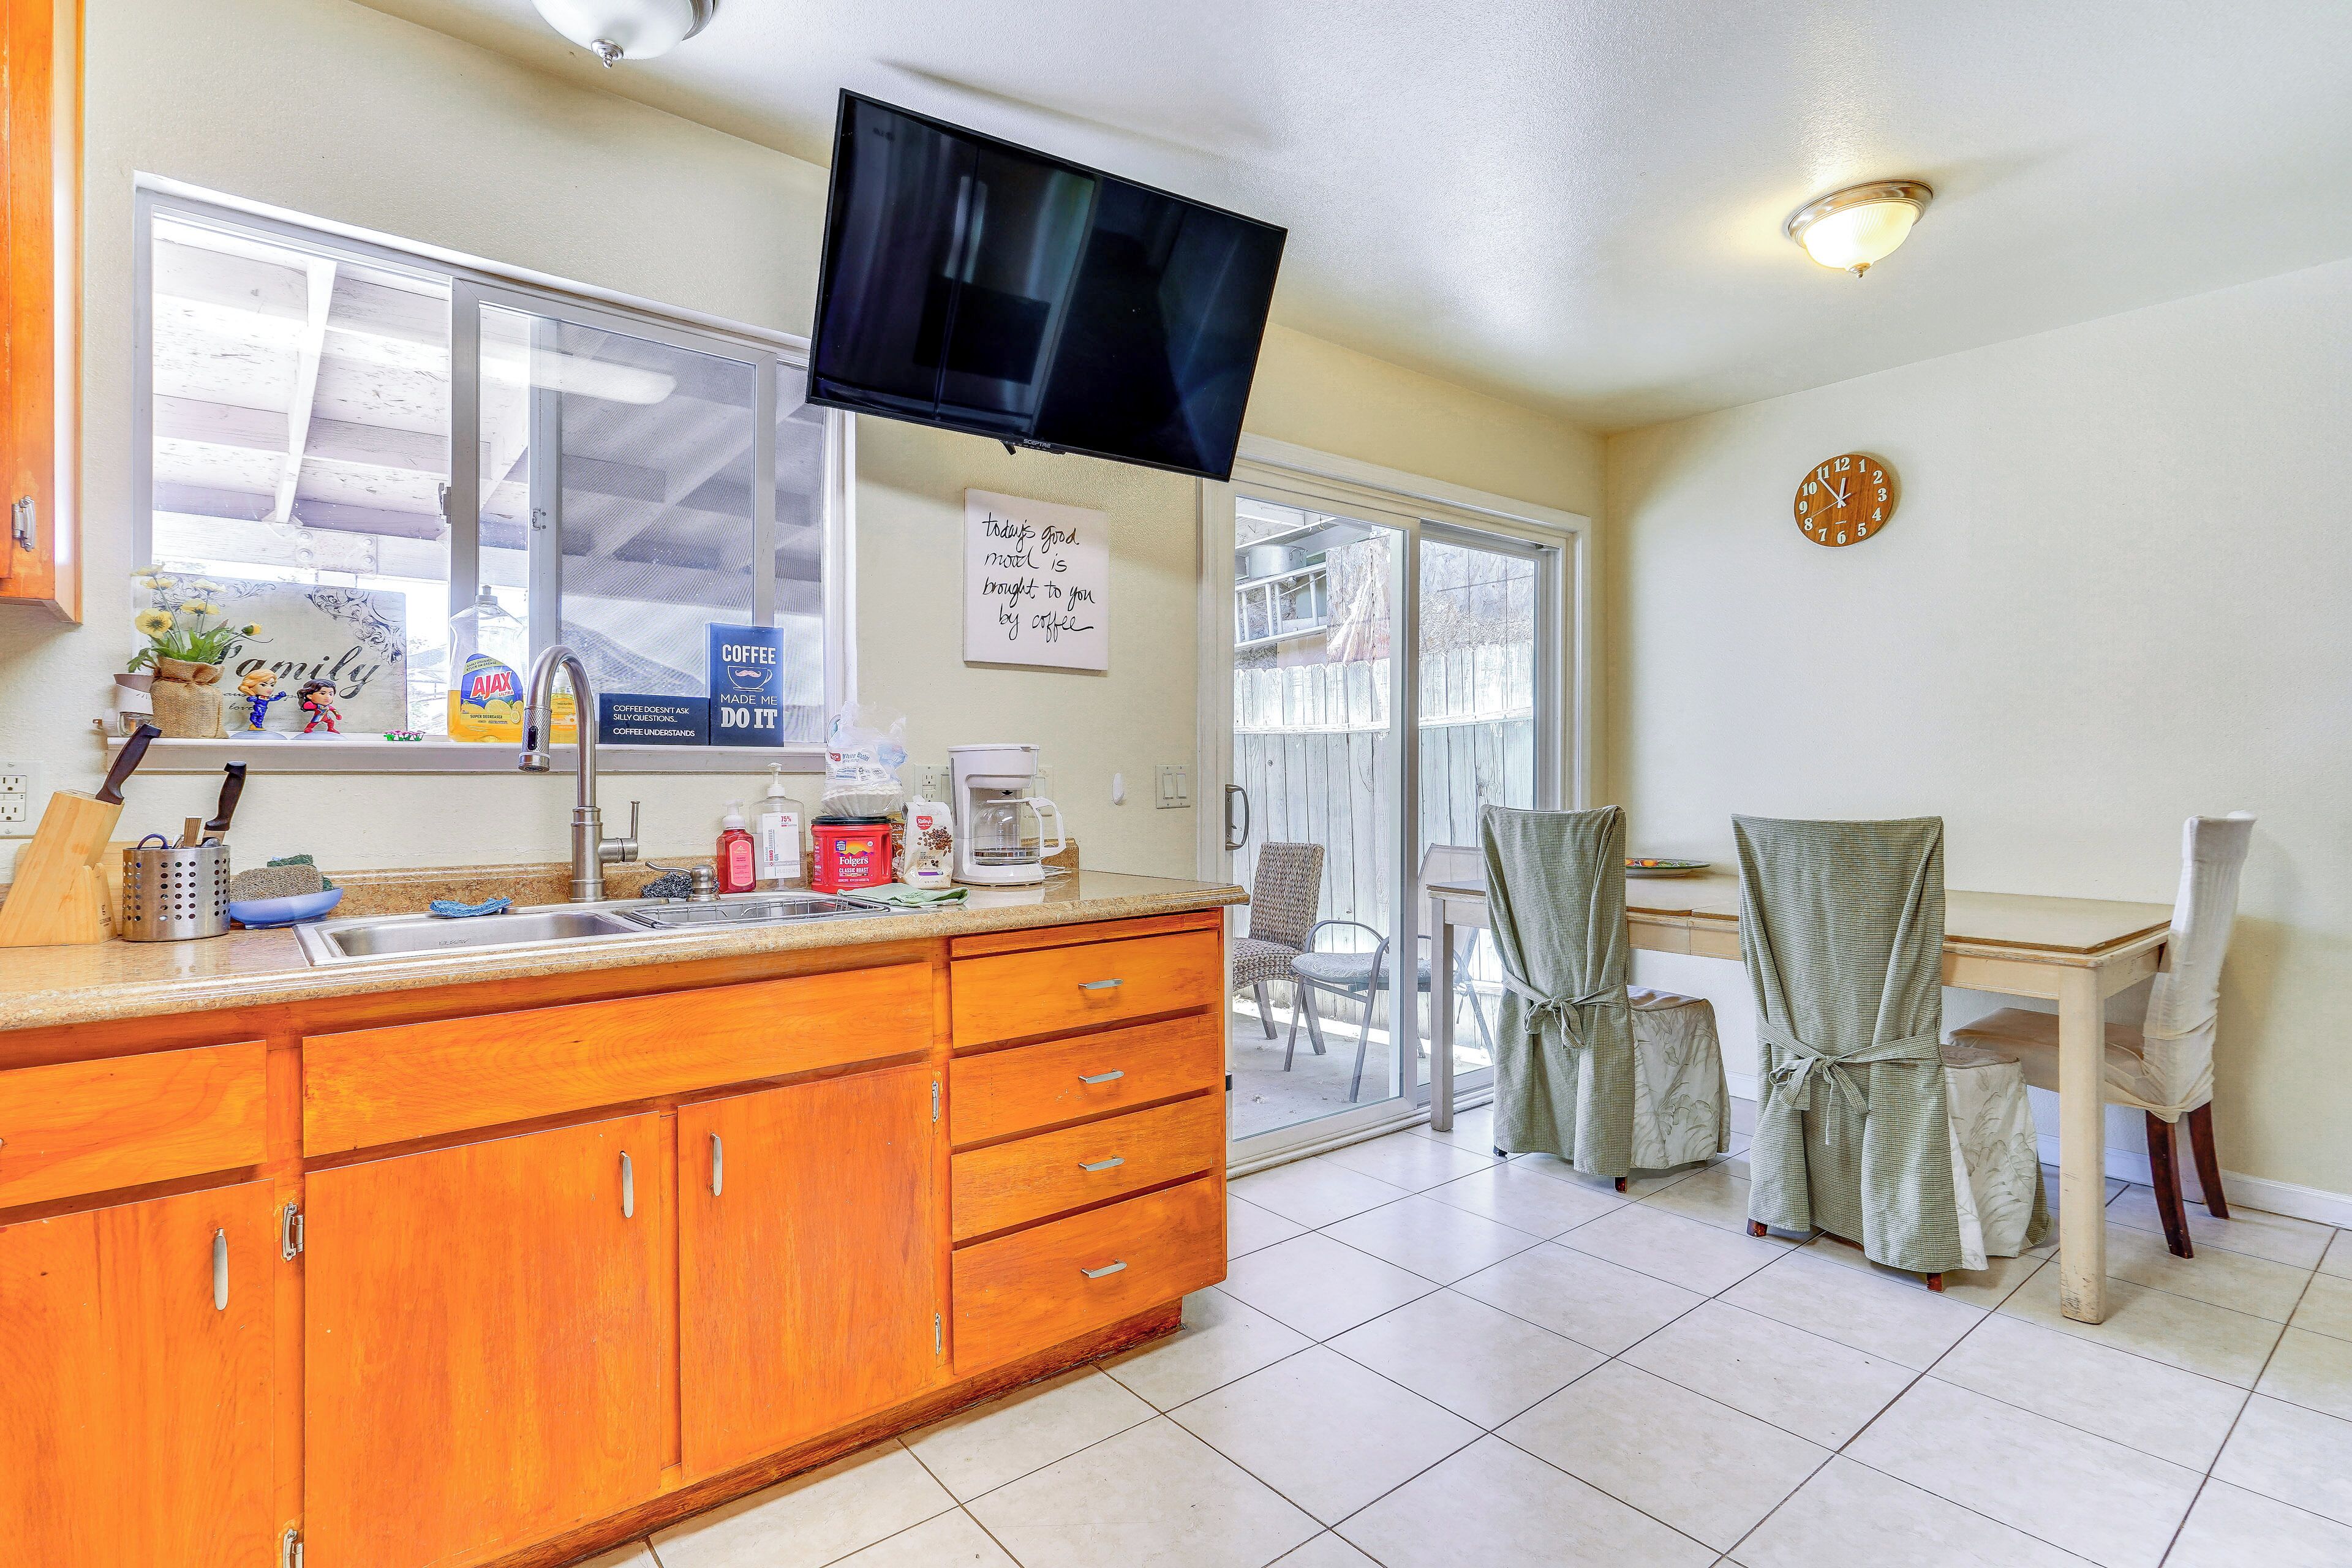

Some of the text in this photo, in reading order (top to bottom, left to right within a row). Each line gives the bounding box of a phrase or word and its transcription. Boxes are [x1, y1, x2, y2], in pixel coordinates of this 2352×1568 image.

[1023, 439, 1051, 448] SCEPTRE
[1834, 456, 1850, 472] 12
[1858, 459, 1866, 473] 1
[1816, 465, 1830, 480] 11
[1872, 470, 1883, 484] 2
[1802, 481, 1817, 496] 10
[1877, 488, 1887, 502] 3
[1798, 500, 1808, 514] 9
[1872, 507, 1882, 521] 4
[1804, 518, 1813, 531] 8
[1857, 522, 1867, 537] 5
[982, 512, 1079, 554] today's good
[1818, 528, 1827, 542] 7
[1837, 530, 1847, 545] 6
[984, 546, 1068, 572] mood is
[982, 576, 1095, 611] brought to you
[999, 603, 1094, 643] by coffee
[722, 644, 776, 665] COFFEE
[471, 671, 512, 699] AJAX
[720, 694, 777, 705] MADE ME
[721, 707, 777, 729] DO IT
[839, 856, 869, 867] Folgers
